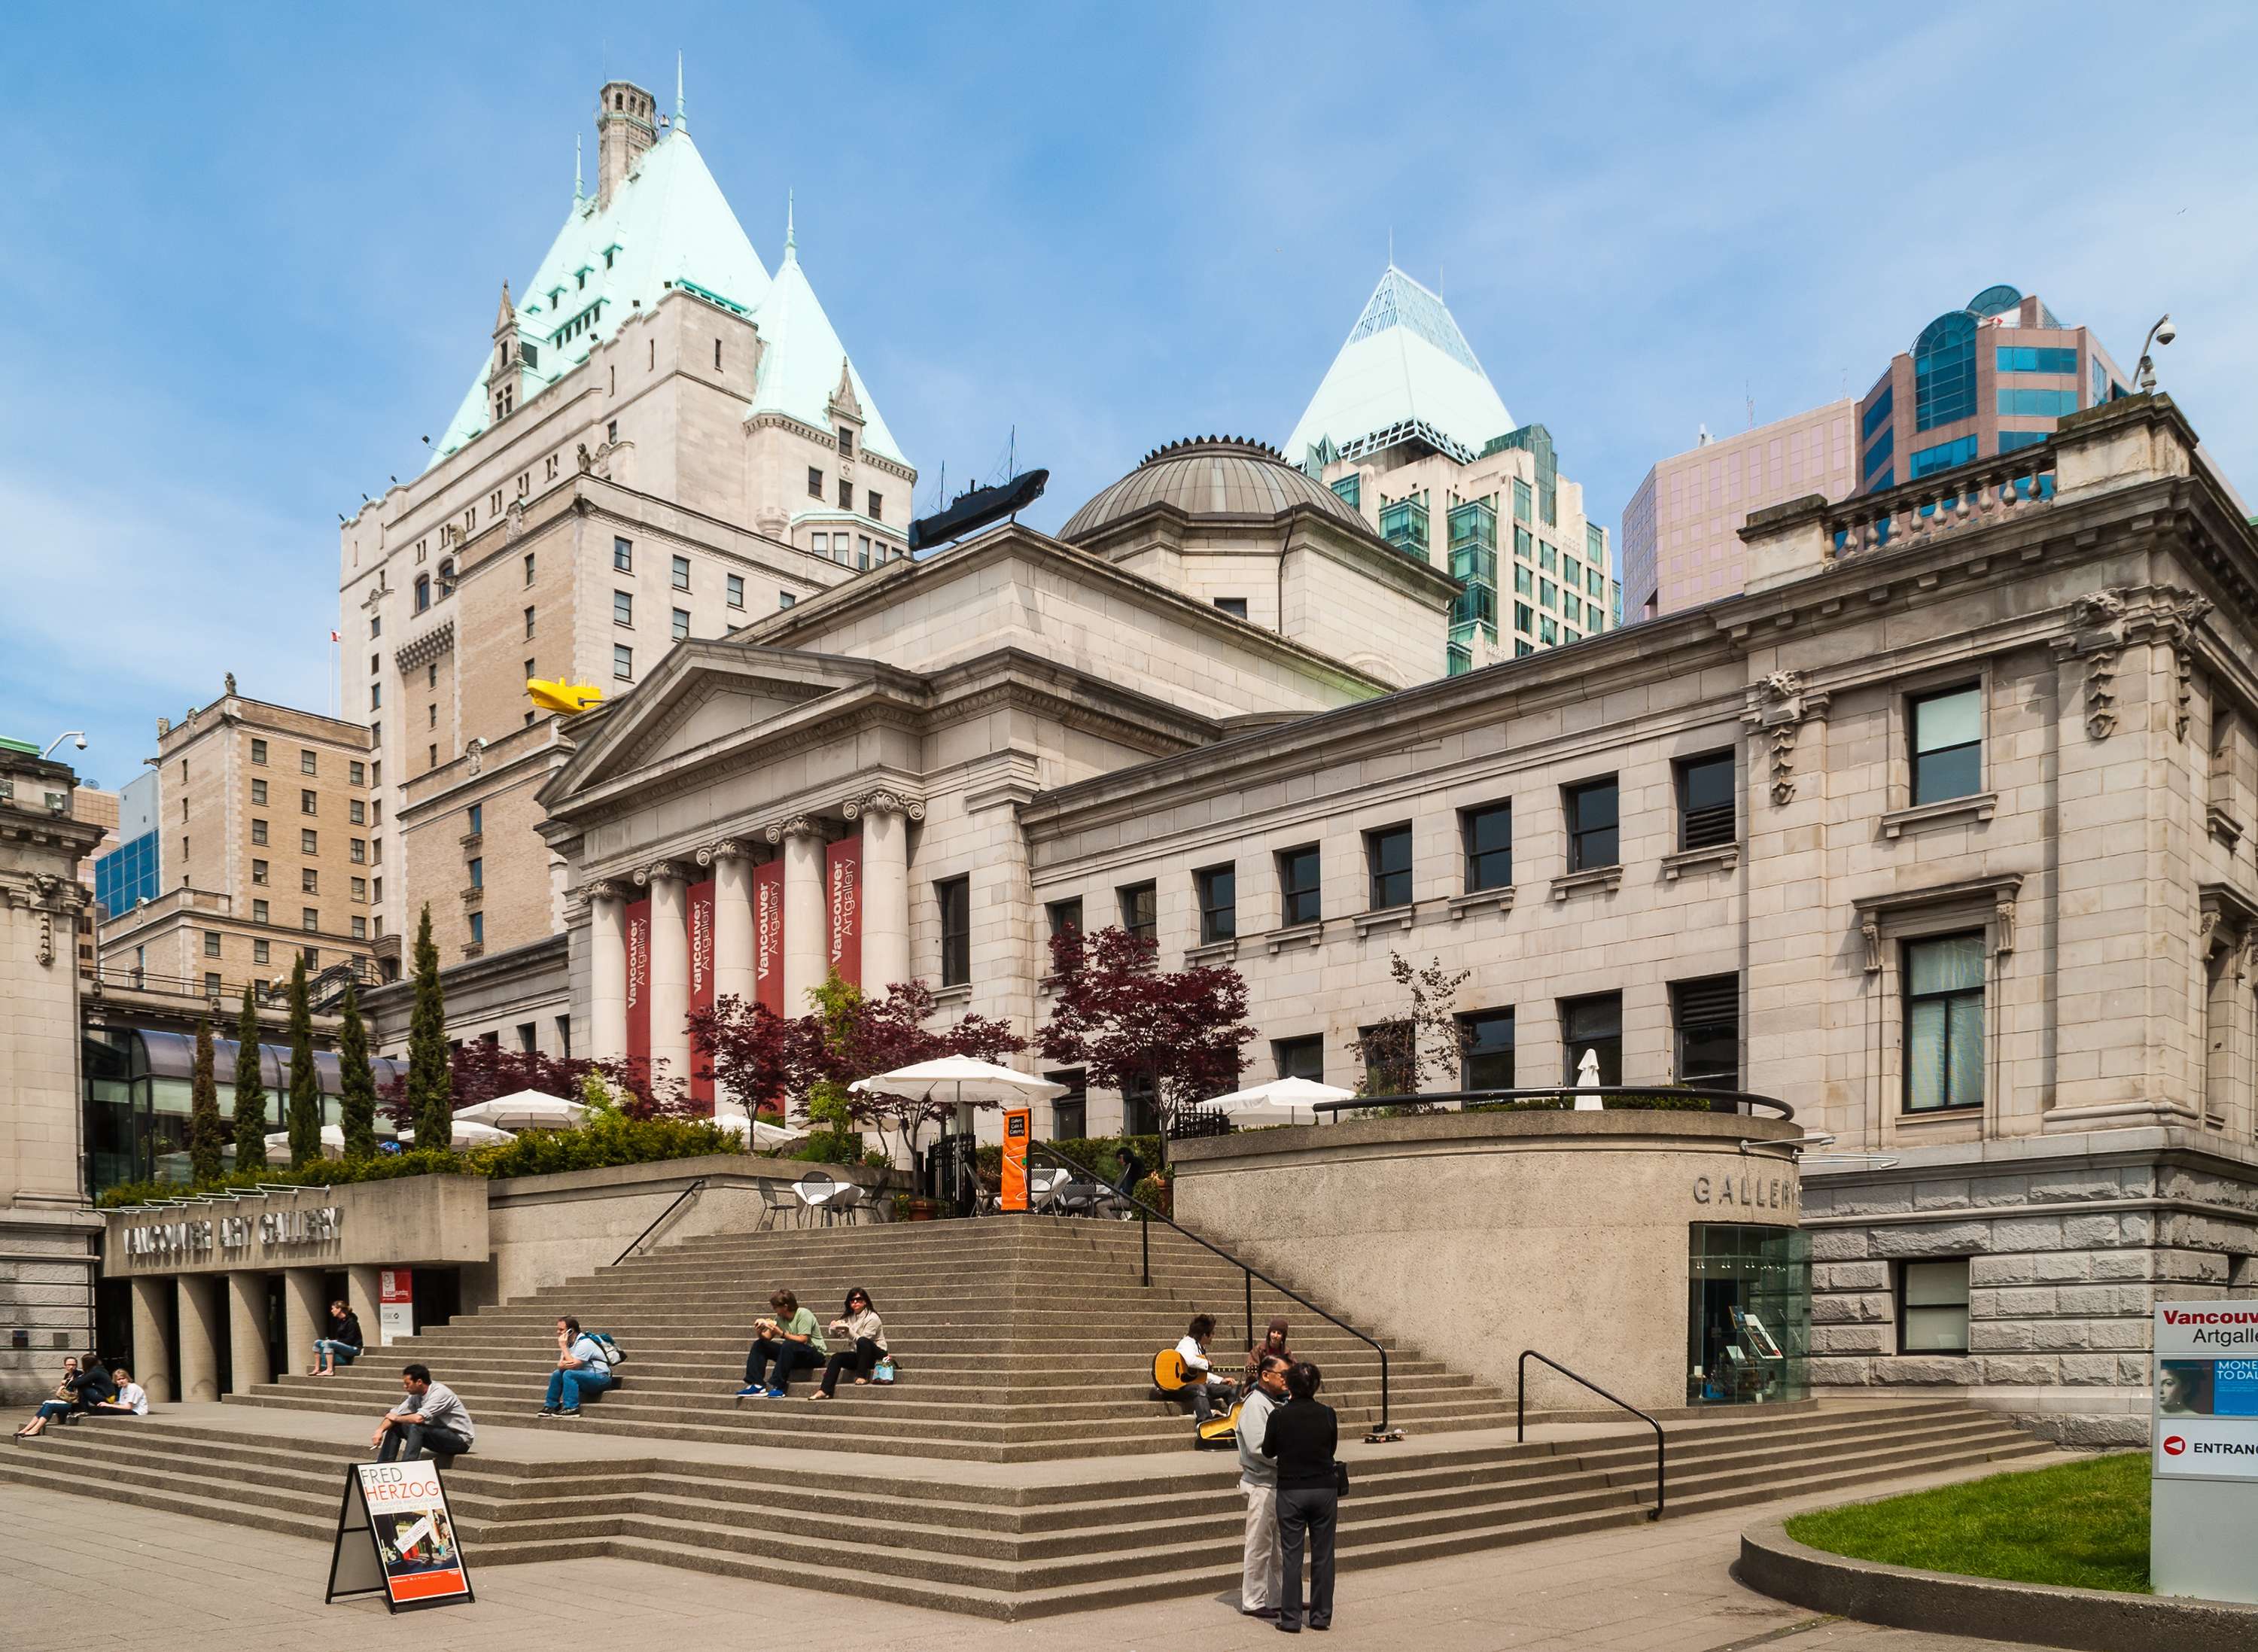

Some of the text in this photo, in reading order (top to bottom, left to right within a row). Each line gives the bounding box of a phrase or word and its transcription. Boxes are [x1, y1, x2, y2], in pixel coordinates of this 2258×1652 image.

[758, 883, 769, 980] Vancouver
[768, 881, 781, 955] Artgallery
[832, 861, 843, 964] Vancouver
[842, 859, 856, 936] Artgallery
[628, 920, 638, 1009] Vancouver
[636, 917, 647, 986] Artgallery
[701, 900, 711, 972] Artgallery
[123, 1206, 344, 1254] VANCOUVER ART GALLERY
[2163, 1310, 2258, 1325] Vancouv
[2217, 1371, 2235, 1380] TO
[361, 1468, 403, 1485] FRED
[2194, 1443, 2258, 1455] ENTRAN
[364, 1480, 439, 1501] HERZOG
